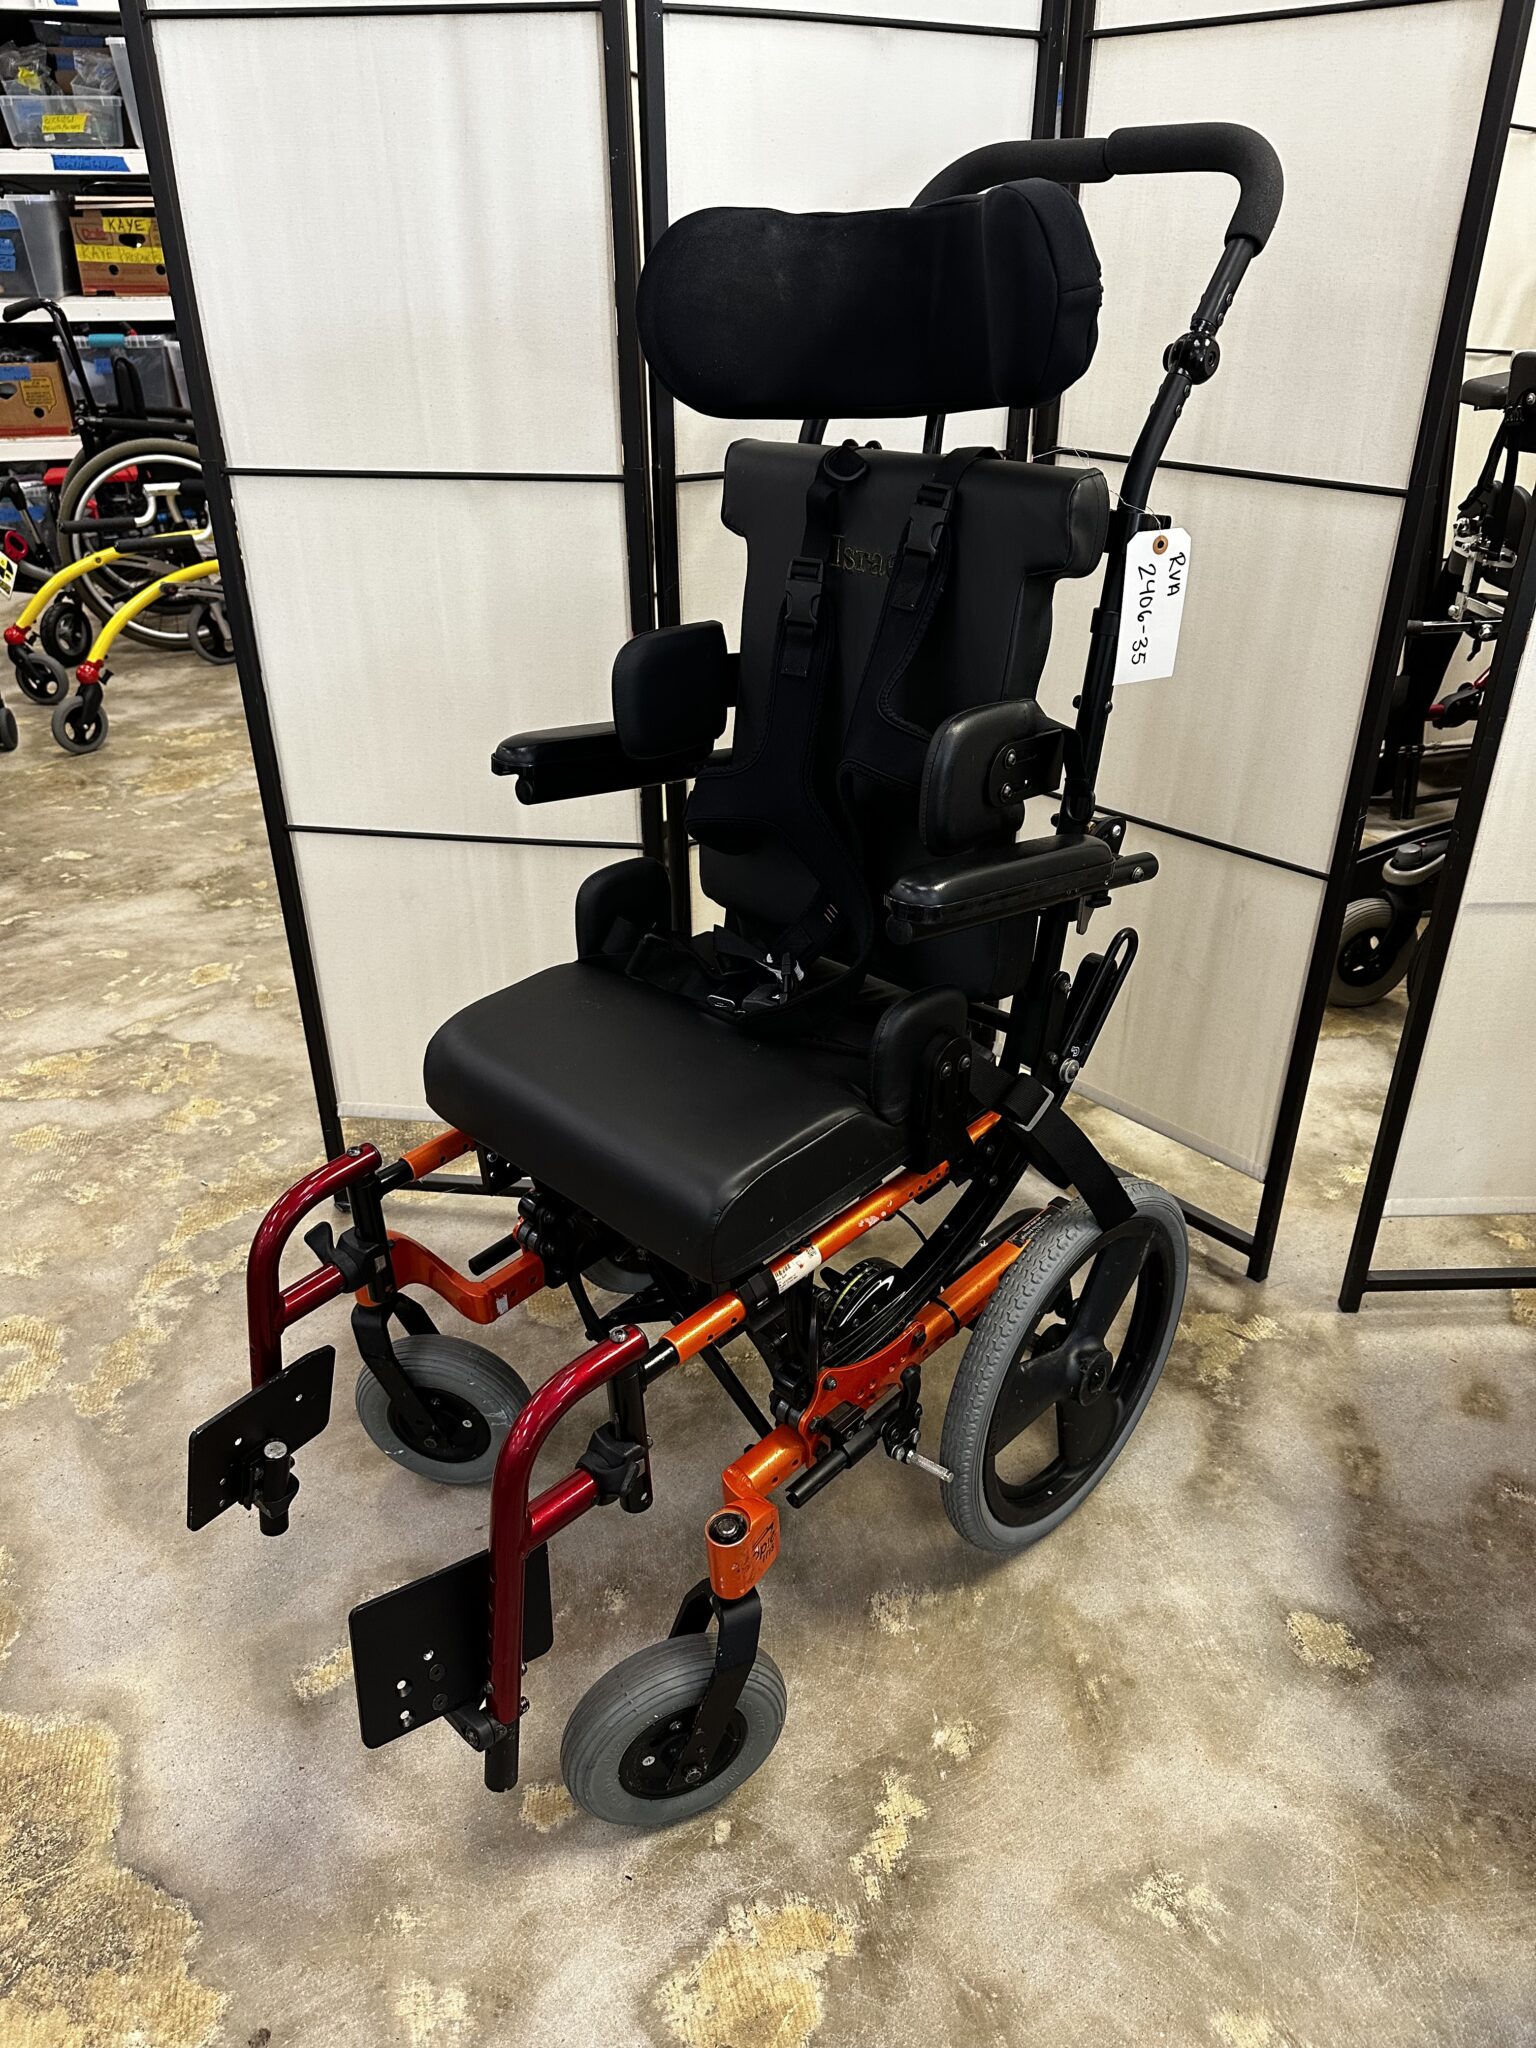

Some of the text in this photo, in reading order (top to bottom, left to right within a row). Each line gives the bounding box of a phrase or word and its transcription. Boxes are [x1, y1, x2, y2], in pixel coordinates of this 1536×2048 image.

[108, 218, 145, 232] KAYE
[1167, 551, 1187, 597] RVA
[1131, 563, 1157, 665] 2406-35
